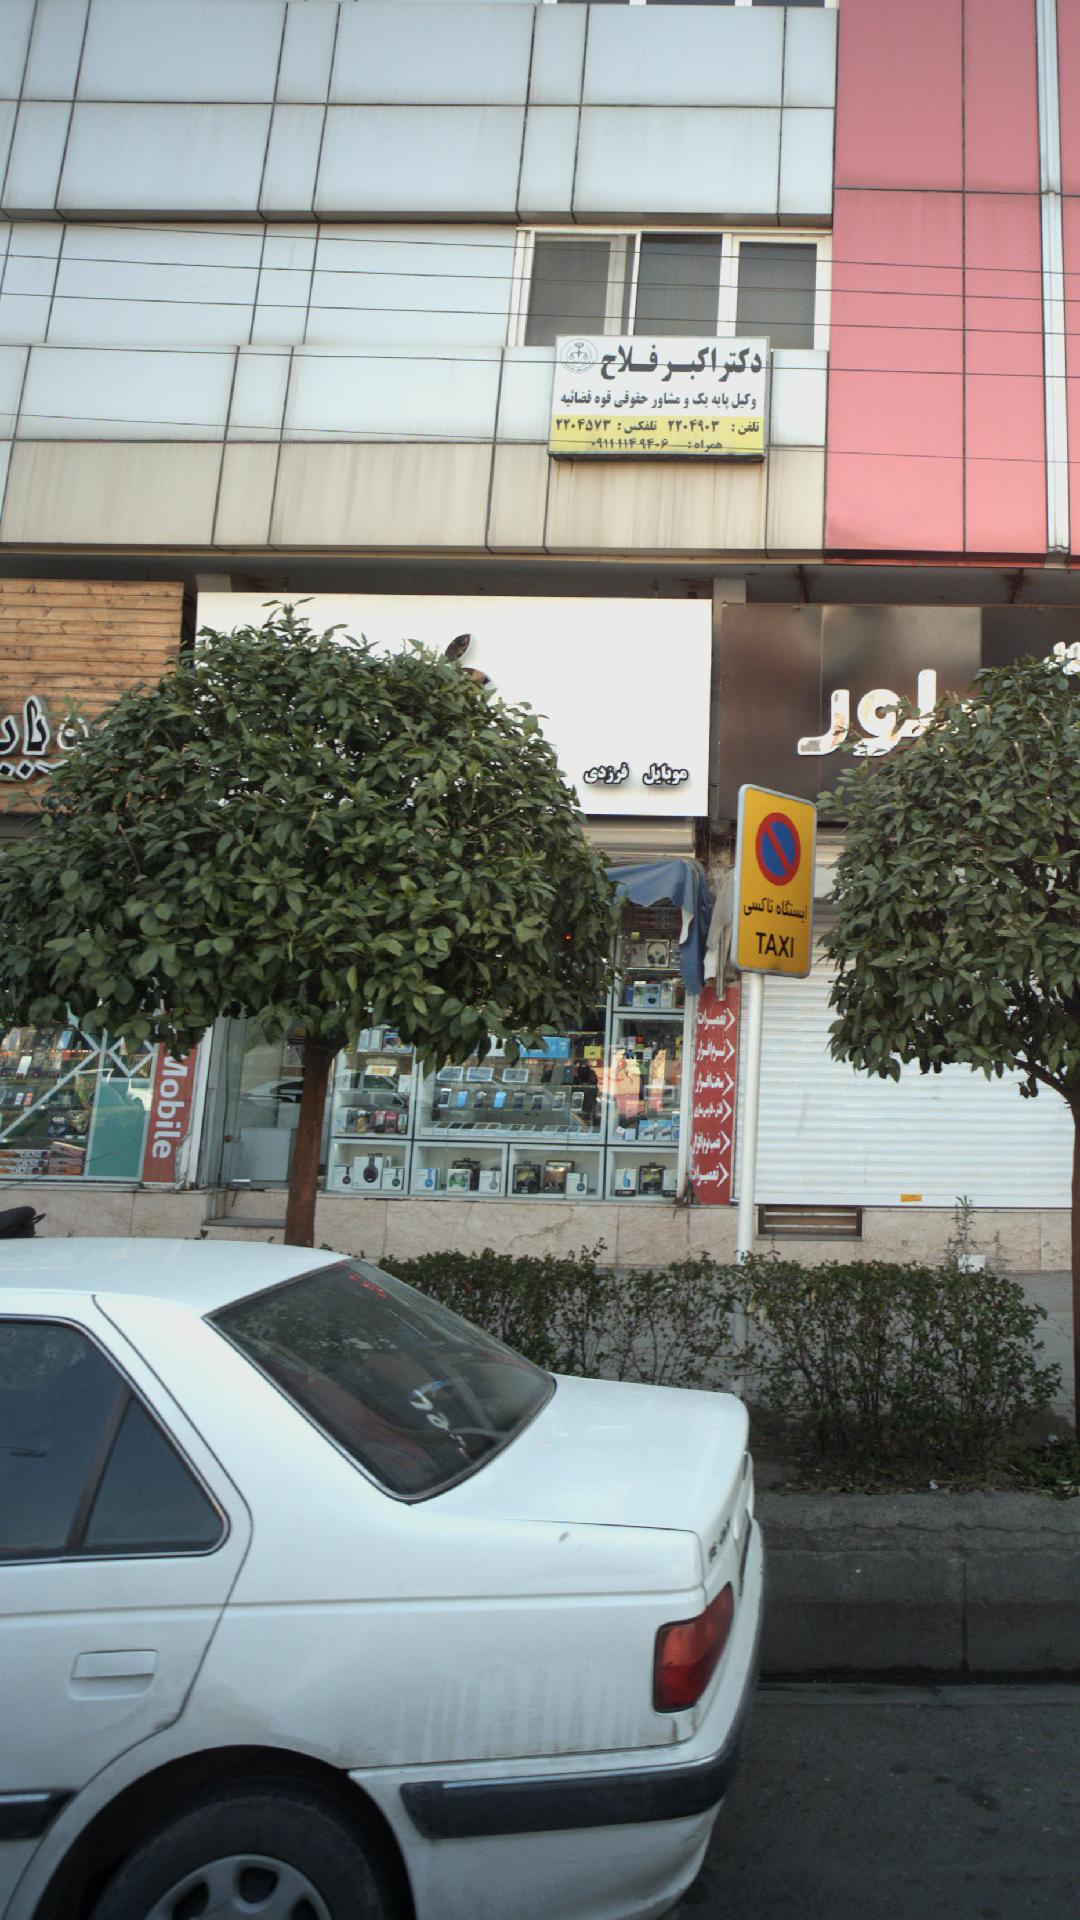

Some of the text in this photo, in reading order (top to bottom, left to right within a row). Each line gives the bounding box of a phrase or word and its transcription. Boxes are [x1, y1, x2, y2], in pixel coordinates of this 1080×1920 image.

[601, 344, 762, 382] دکتر اکبر فلاح
[595, 390, 612, 408] قوه
[613, 390, 648, 409] حقوقی
[651, 392, 681, 409] مشاور
[683, 397, 689, 409] و
[692, 392, 708, 408] یک
[712, 392, 729, 409] پایه
[731, 392, 757, 409] وکیل
[556, 419, 611, 431] ۲۲۰۴۵۷۳
[668, 419, 720, 432] ۲۲۰۴۹۰۳
[642, 763, 689, 785] موبایل
[744, 897, 808, 923] ایستگاه تاکسی
[756, 932, 794, 958] TAXI
[152, 1050, 188, 1158] Mobile
